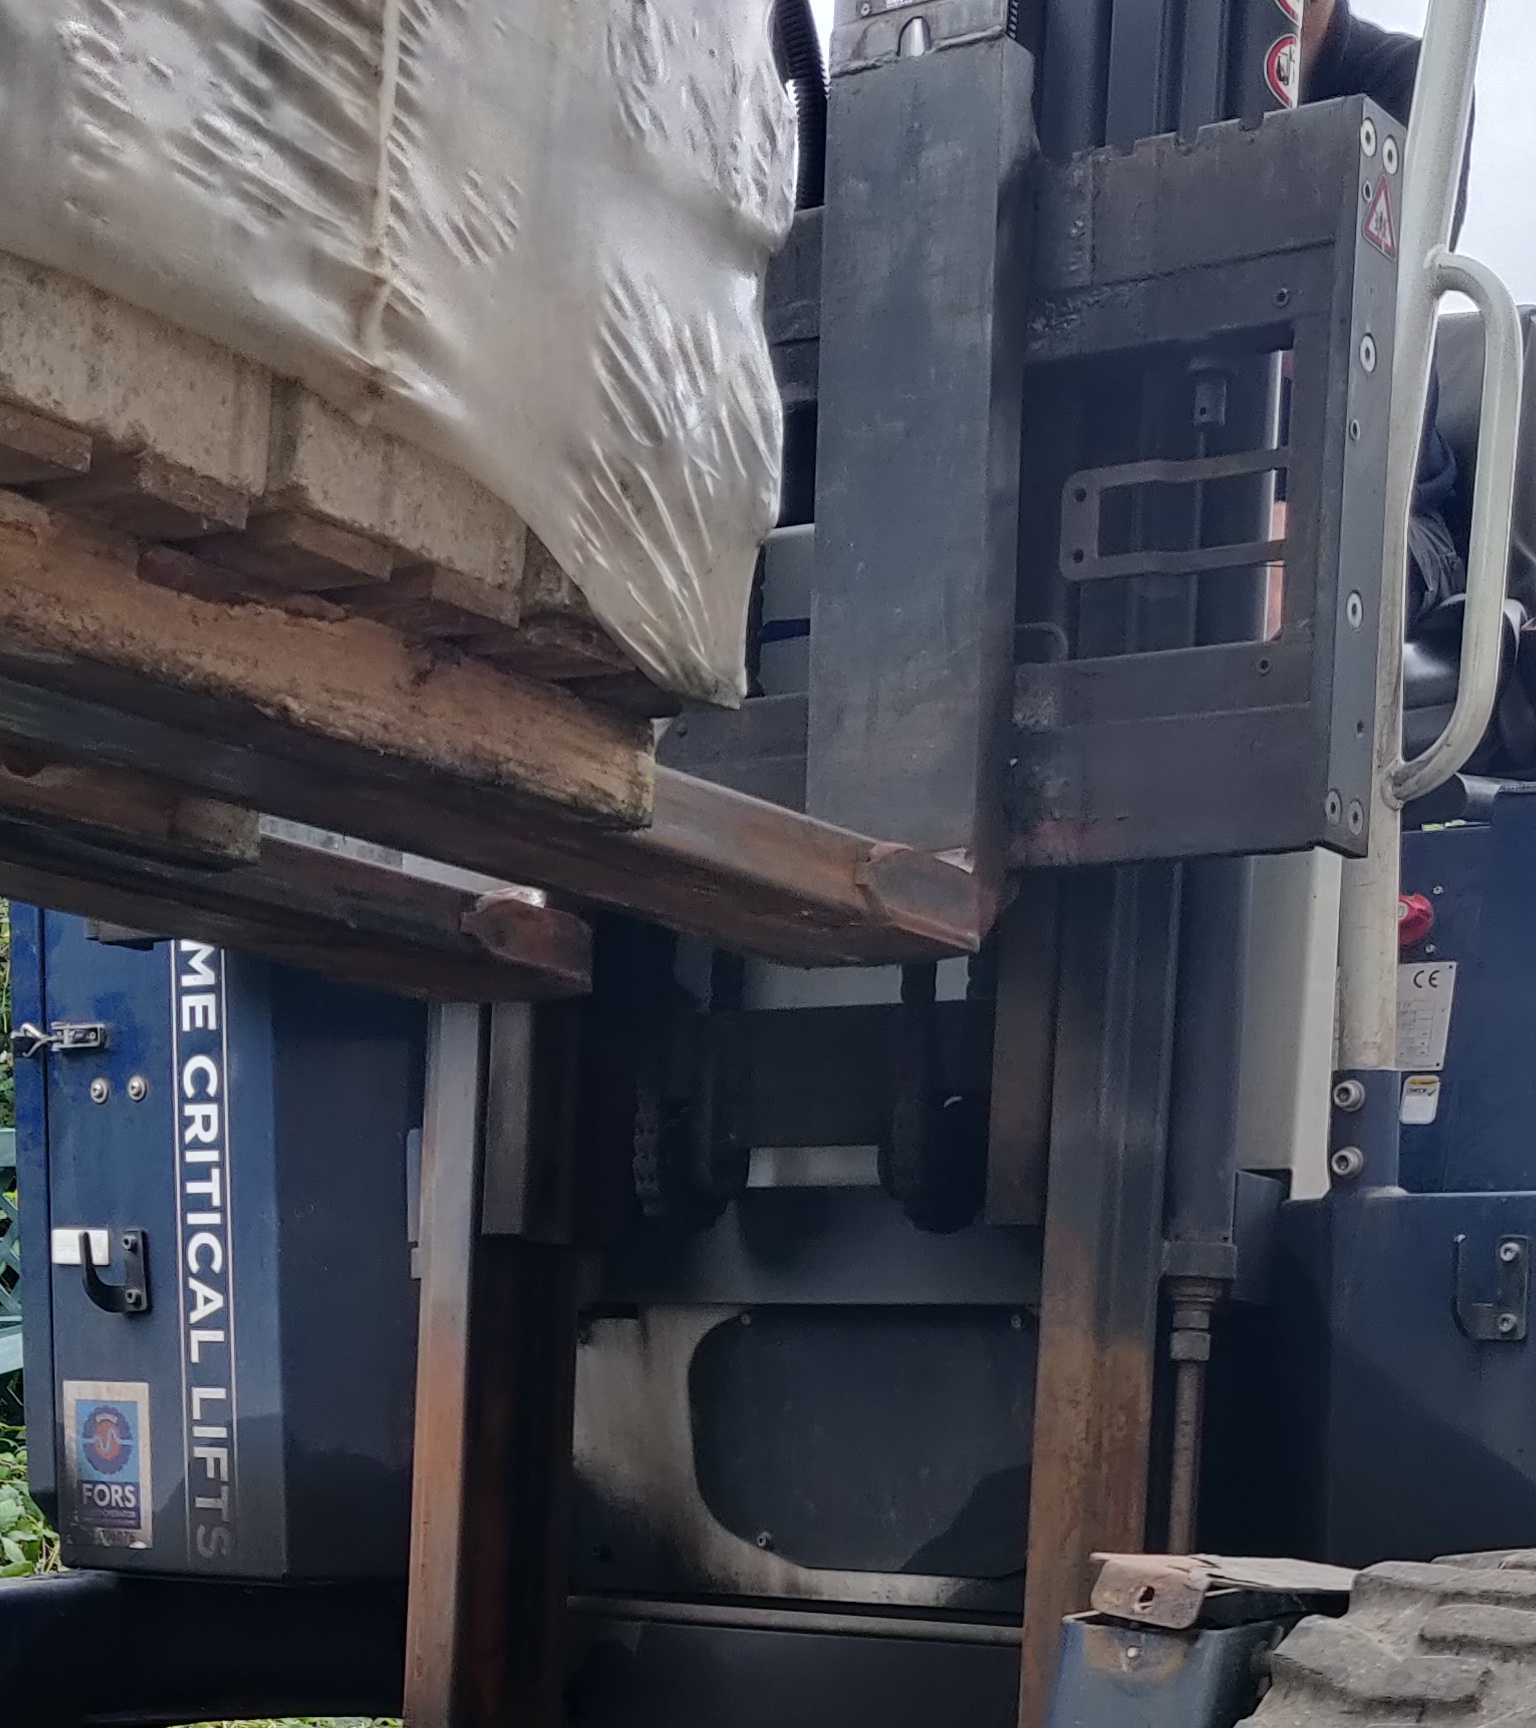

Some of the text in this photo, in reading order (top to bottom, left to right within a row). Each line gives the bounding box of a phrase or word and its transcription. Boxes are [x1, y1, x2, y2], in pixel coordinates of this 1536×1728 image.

[1413, 970, 1440, 989] CE
[183, 1054, 224, 1364] CRITICAL
[82, 1483, 137, 1508] FORS
[191, 1387, 233, 1558] LIFTS
